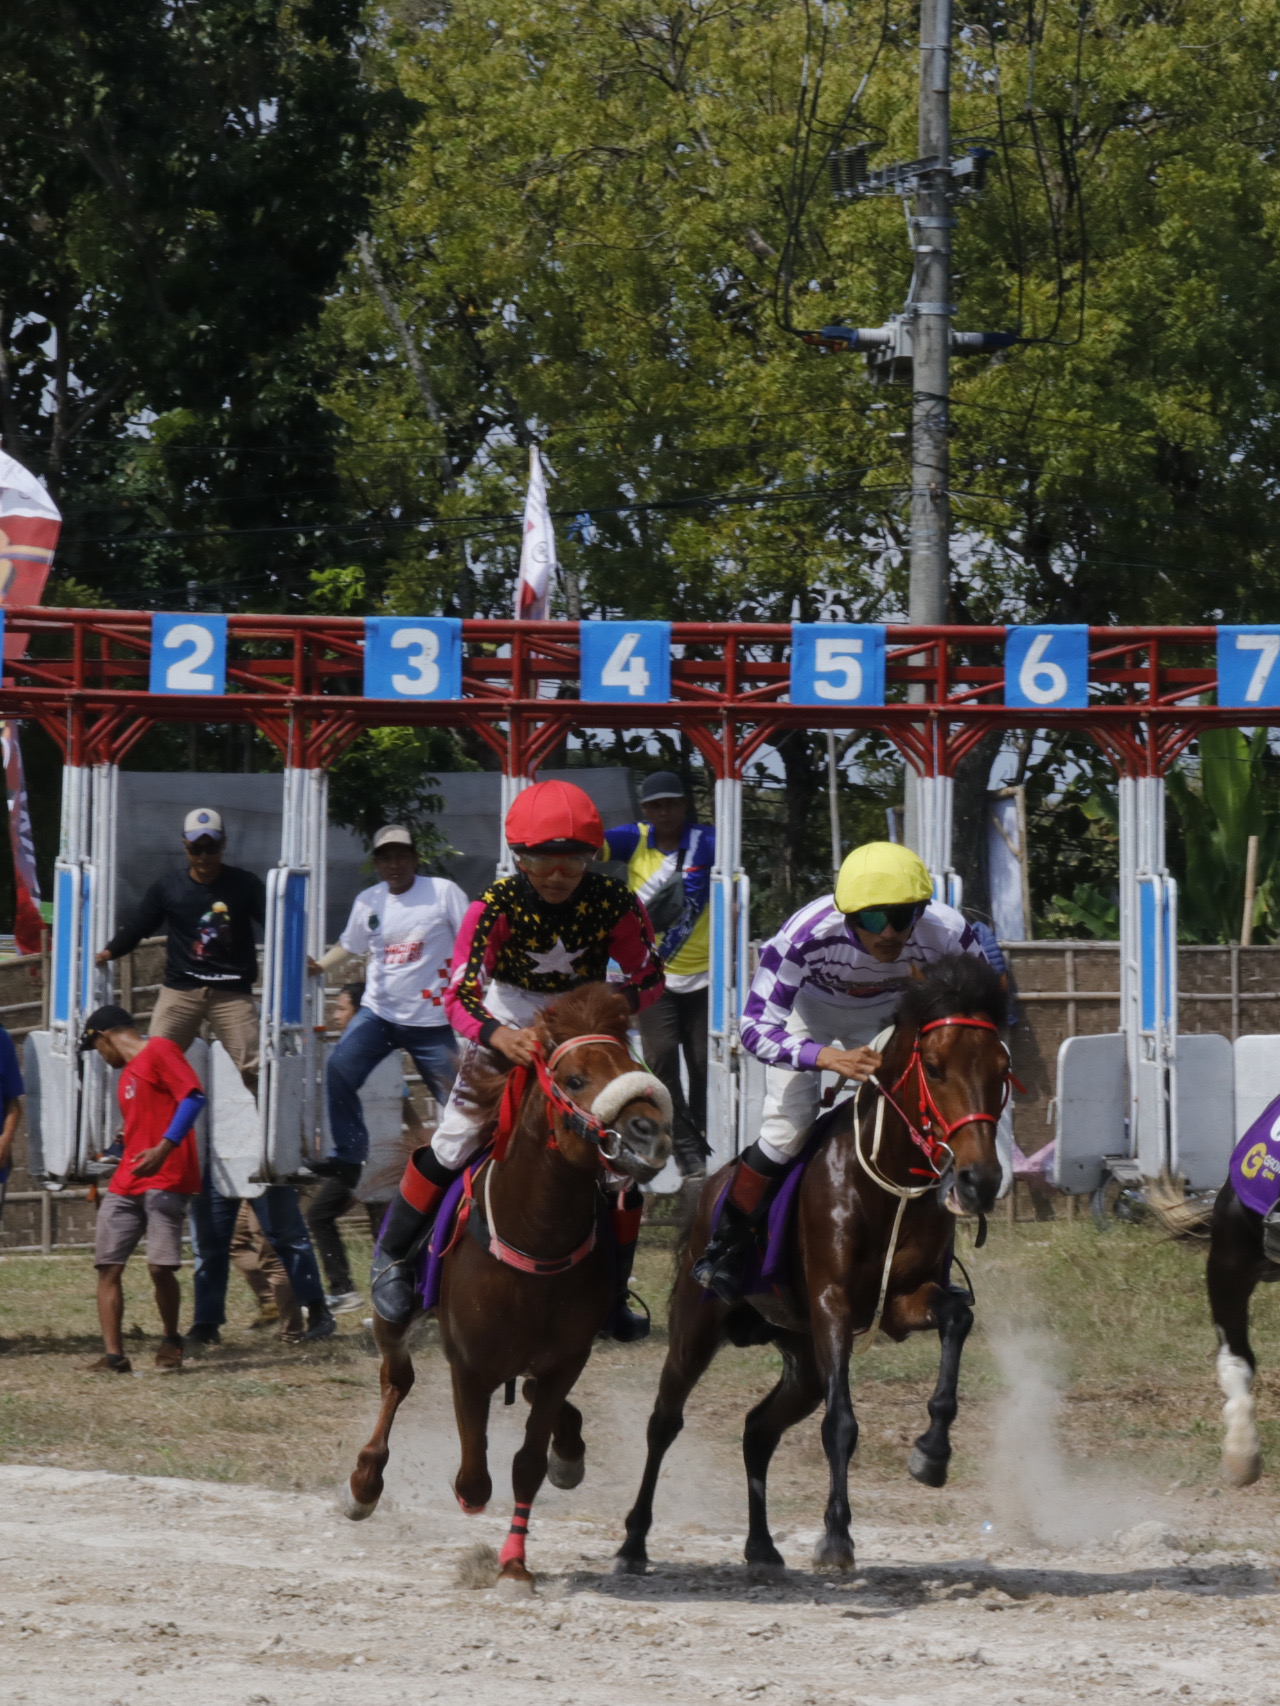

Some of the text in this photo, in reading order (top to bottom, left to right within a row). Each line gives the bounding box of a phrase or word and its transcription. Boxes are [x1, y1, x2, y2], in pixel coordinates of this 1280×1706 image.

[163, 624, 214, 691] 2
[391, 628, 440, 695] 3
[600, 633, 650, 696] 4
[813, 638, 863, 700] 5
[1019, 634, 1068, 705] 6
[1236, 634, 1280, 702] 7
